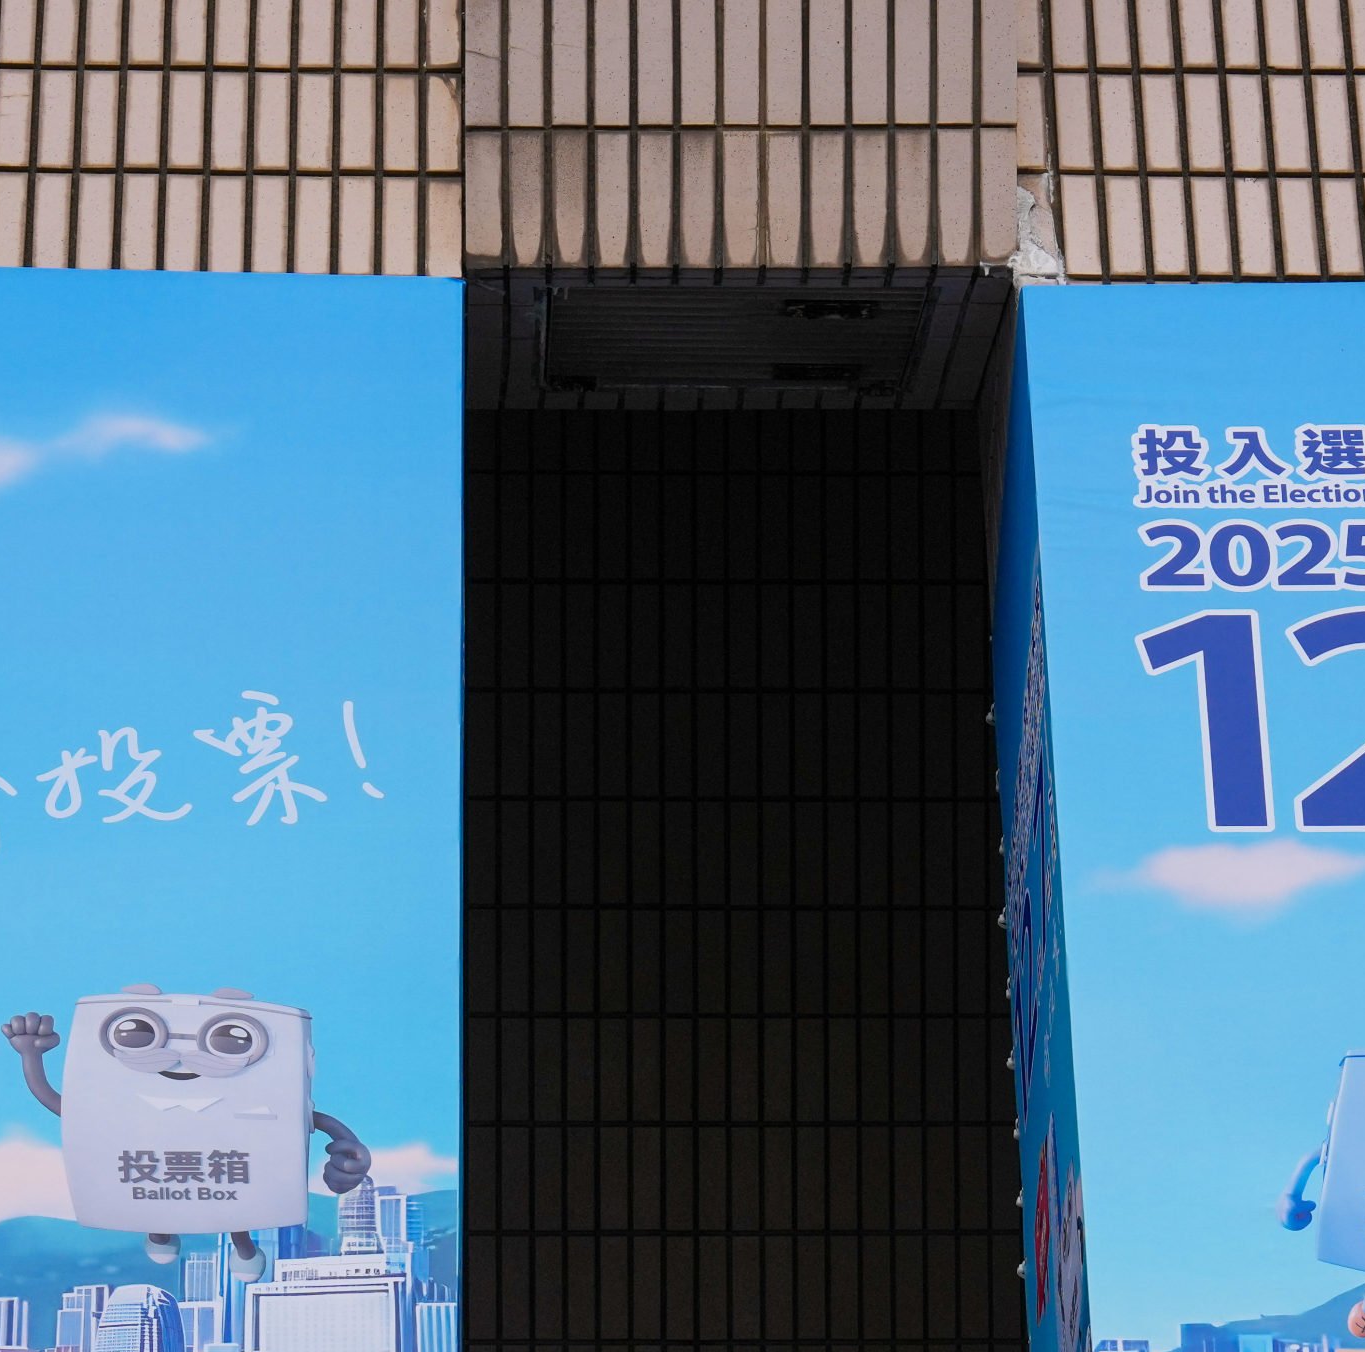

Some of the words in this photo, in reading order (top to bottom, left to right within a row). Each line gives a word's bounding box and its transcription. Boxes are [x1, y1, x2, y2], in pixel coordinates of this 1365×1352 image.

[1140, 484, 1200, 504] Join
[1206, 483, 1256, 504] the
[118, 1149, 251, 1185] 投票箱
[131, 1186, 194, 1202] Ballot
[197, 1187, 239, 1202] Box
